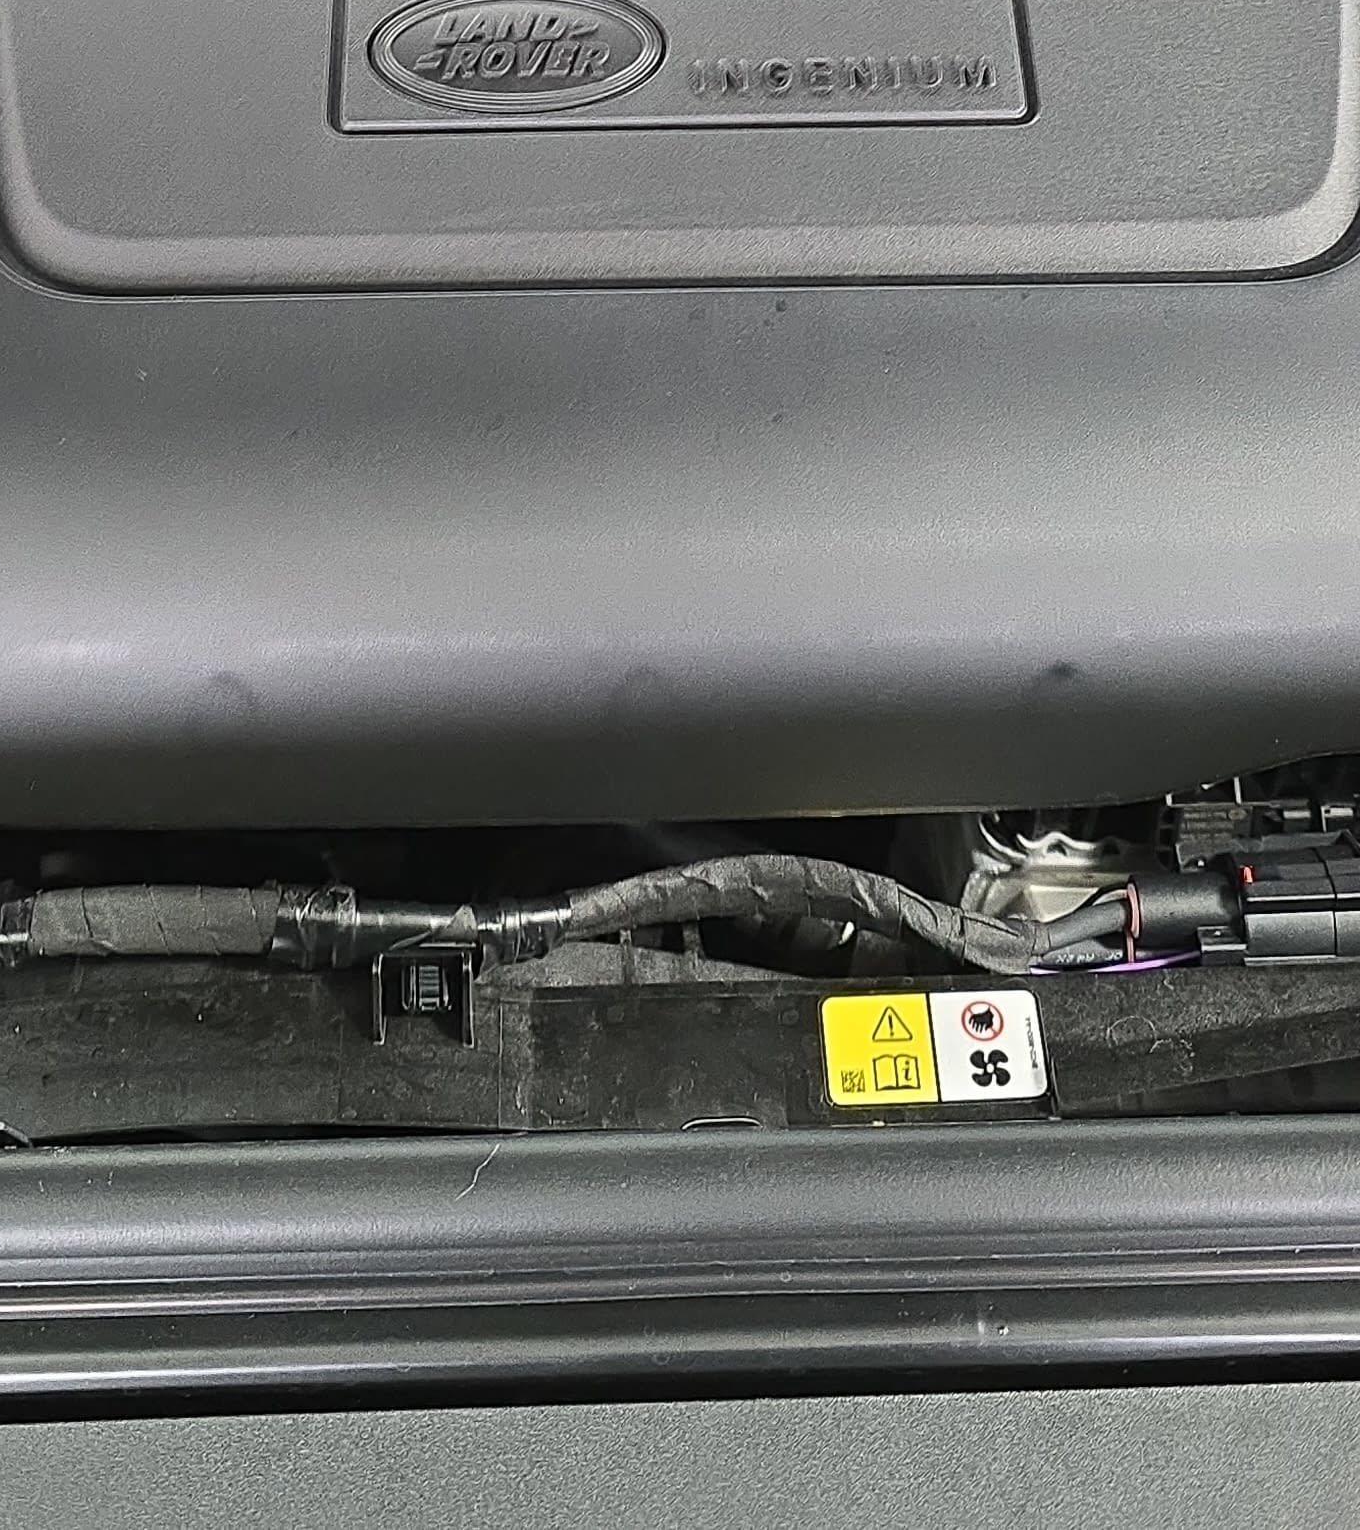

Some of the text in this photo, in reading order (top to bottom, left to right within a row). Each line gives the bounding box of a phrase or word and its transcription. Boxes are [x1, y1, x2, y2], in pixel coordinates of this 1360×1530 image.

[433, 11, 574, 45] LAND
[441, 40, 611, 81] ROVER
[687, 53, 997, 95] INGENIUM
